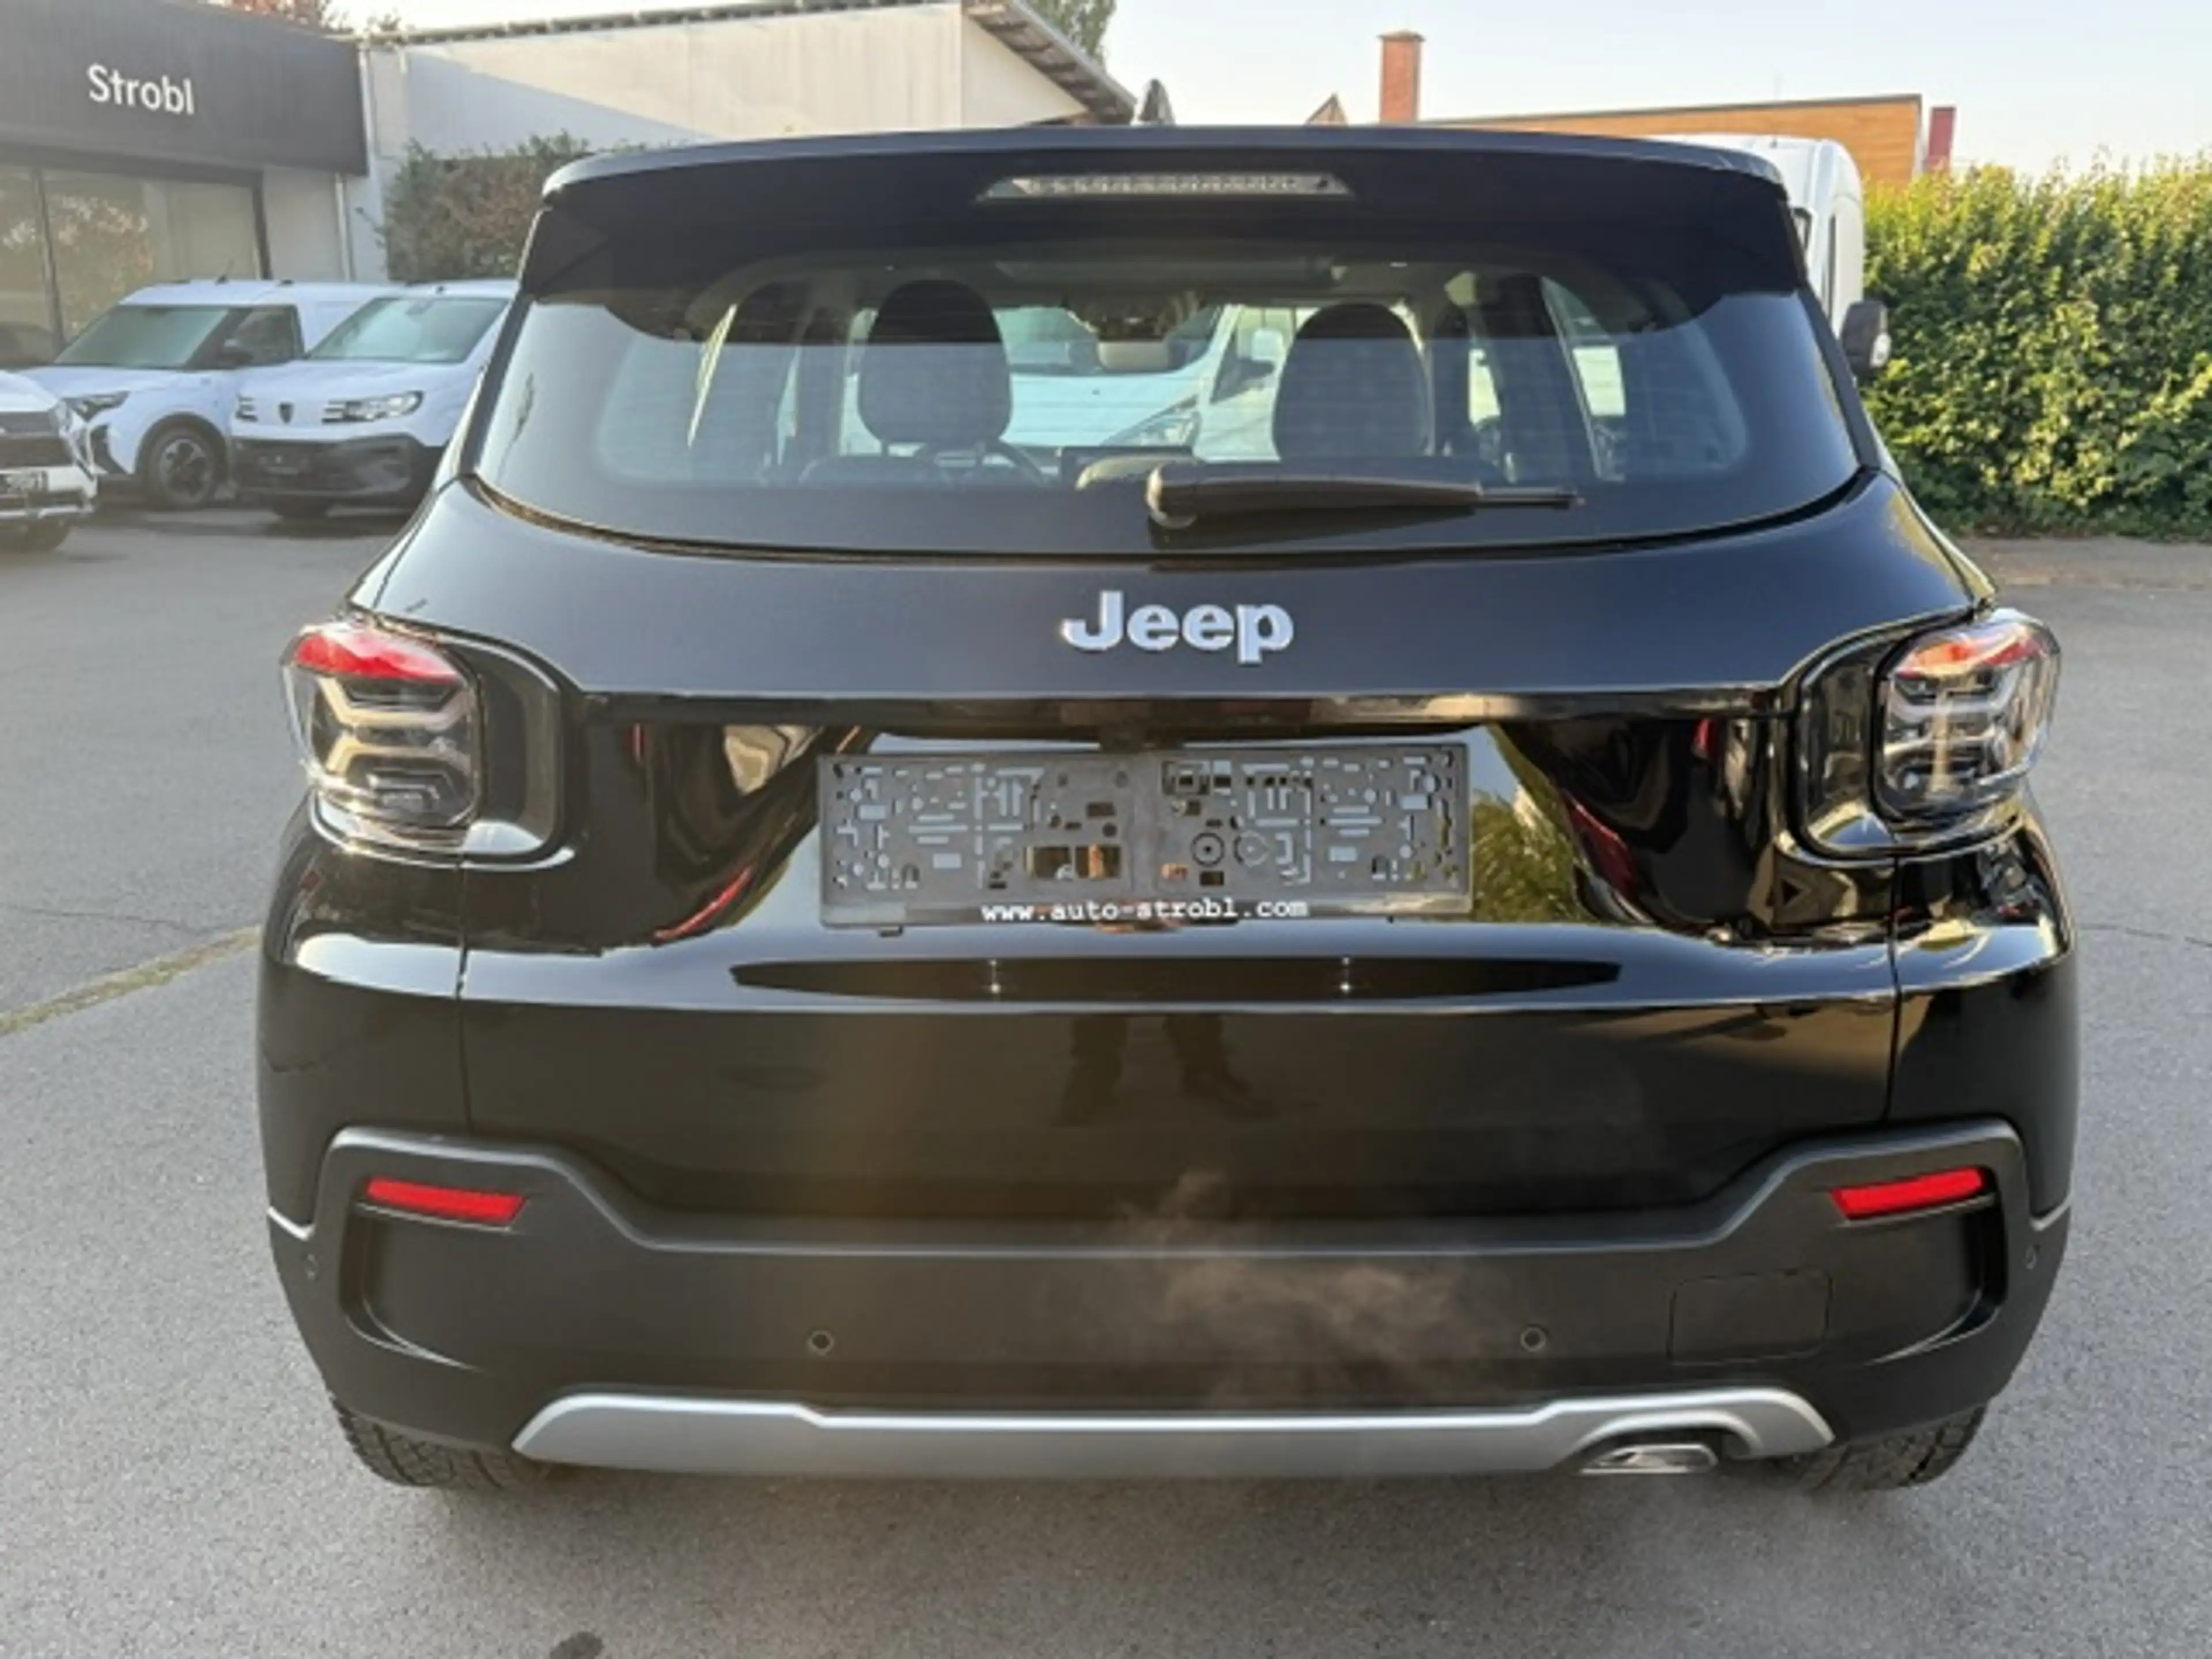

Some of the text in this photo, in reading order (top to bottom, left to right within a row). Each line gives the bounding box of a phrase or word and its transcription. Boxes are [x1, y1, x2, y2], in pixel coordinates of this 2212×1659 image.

[88, 63, 194, 115] Strobl
[1060, 590, 1294, 664] Jeep
[981, 896, 1309, 922] www.auto-strobl.com
